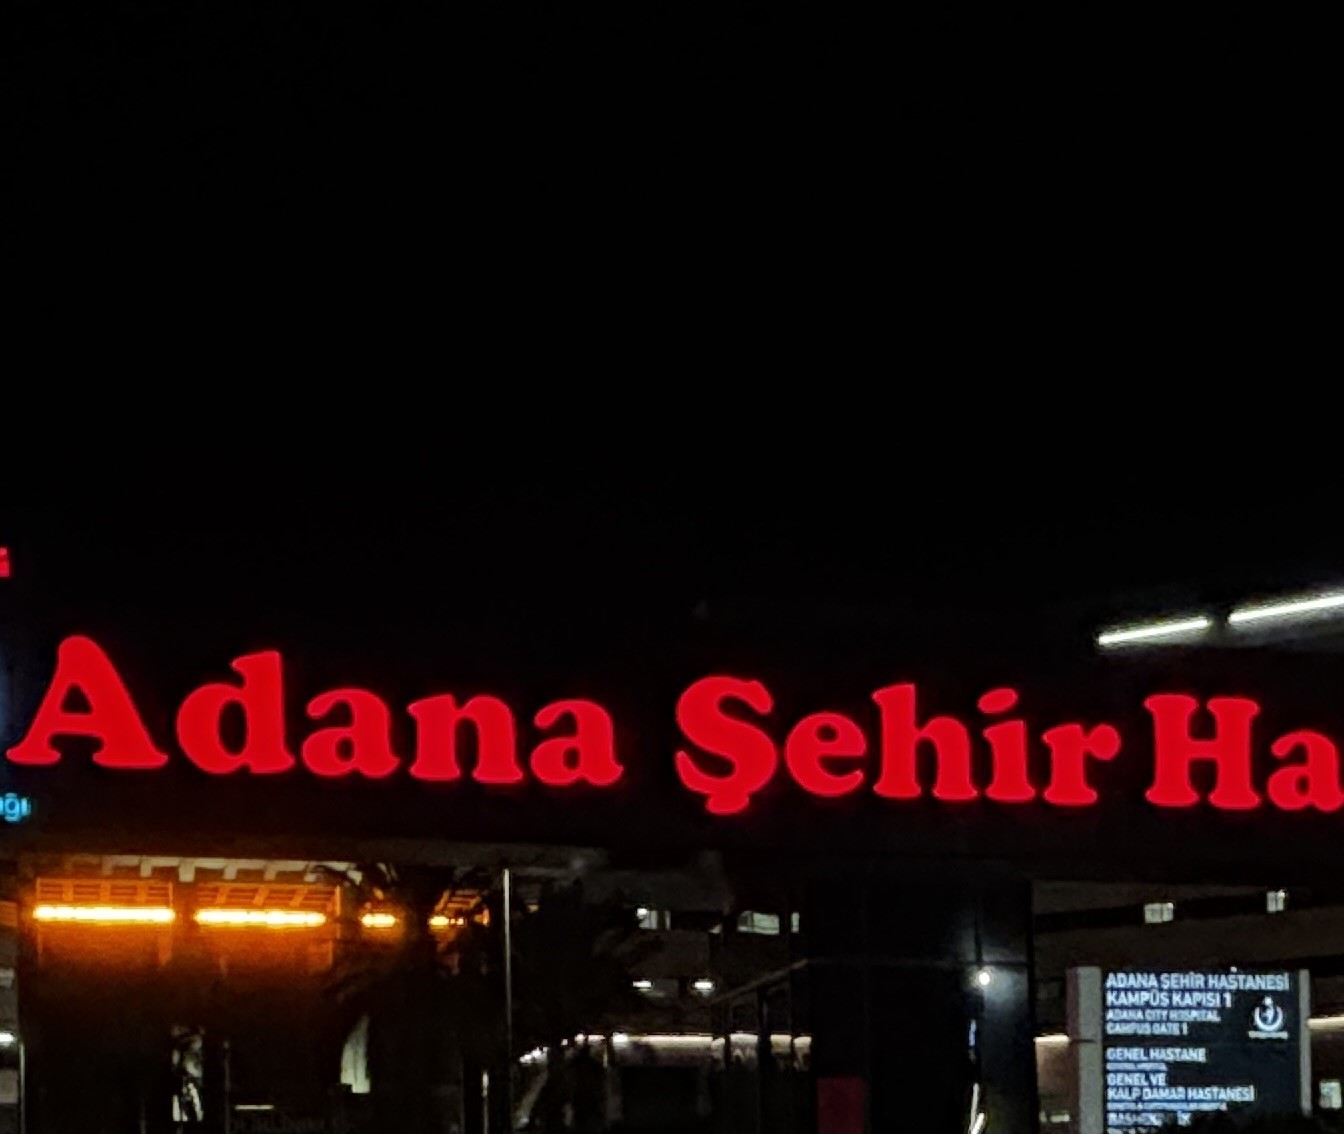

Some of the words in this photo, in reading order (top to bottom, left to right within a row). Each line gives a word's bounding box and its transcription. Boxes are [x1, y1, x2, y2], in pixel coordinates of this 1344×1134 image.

[4, 634, 626, 787] Adana
[674, 675, 1123, 816] Şehir
[1106, 973, 1157, 988] ADANA
[1161, 972, 1205, 990] ŞEHİR
[1106, 990, 1170, 1007] KAMPÜS
[1172, 992, 1221, 1007] KAPISI
[1223, 992, 1232, 1008] 1
[1106, 1048, 1148, 1061] GENEL
[1150, 1048, 1206, 1062] HASTANE
[1106, 1073, 1148, 1086] GENEL
[1150, 1073, 1167, 1086] VE
[1106, 1087, 1140, 1100] KALP
